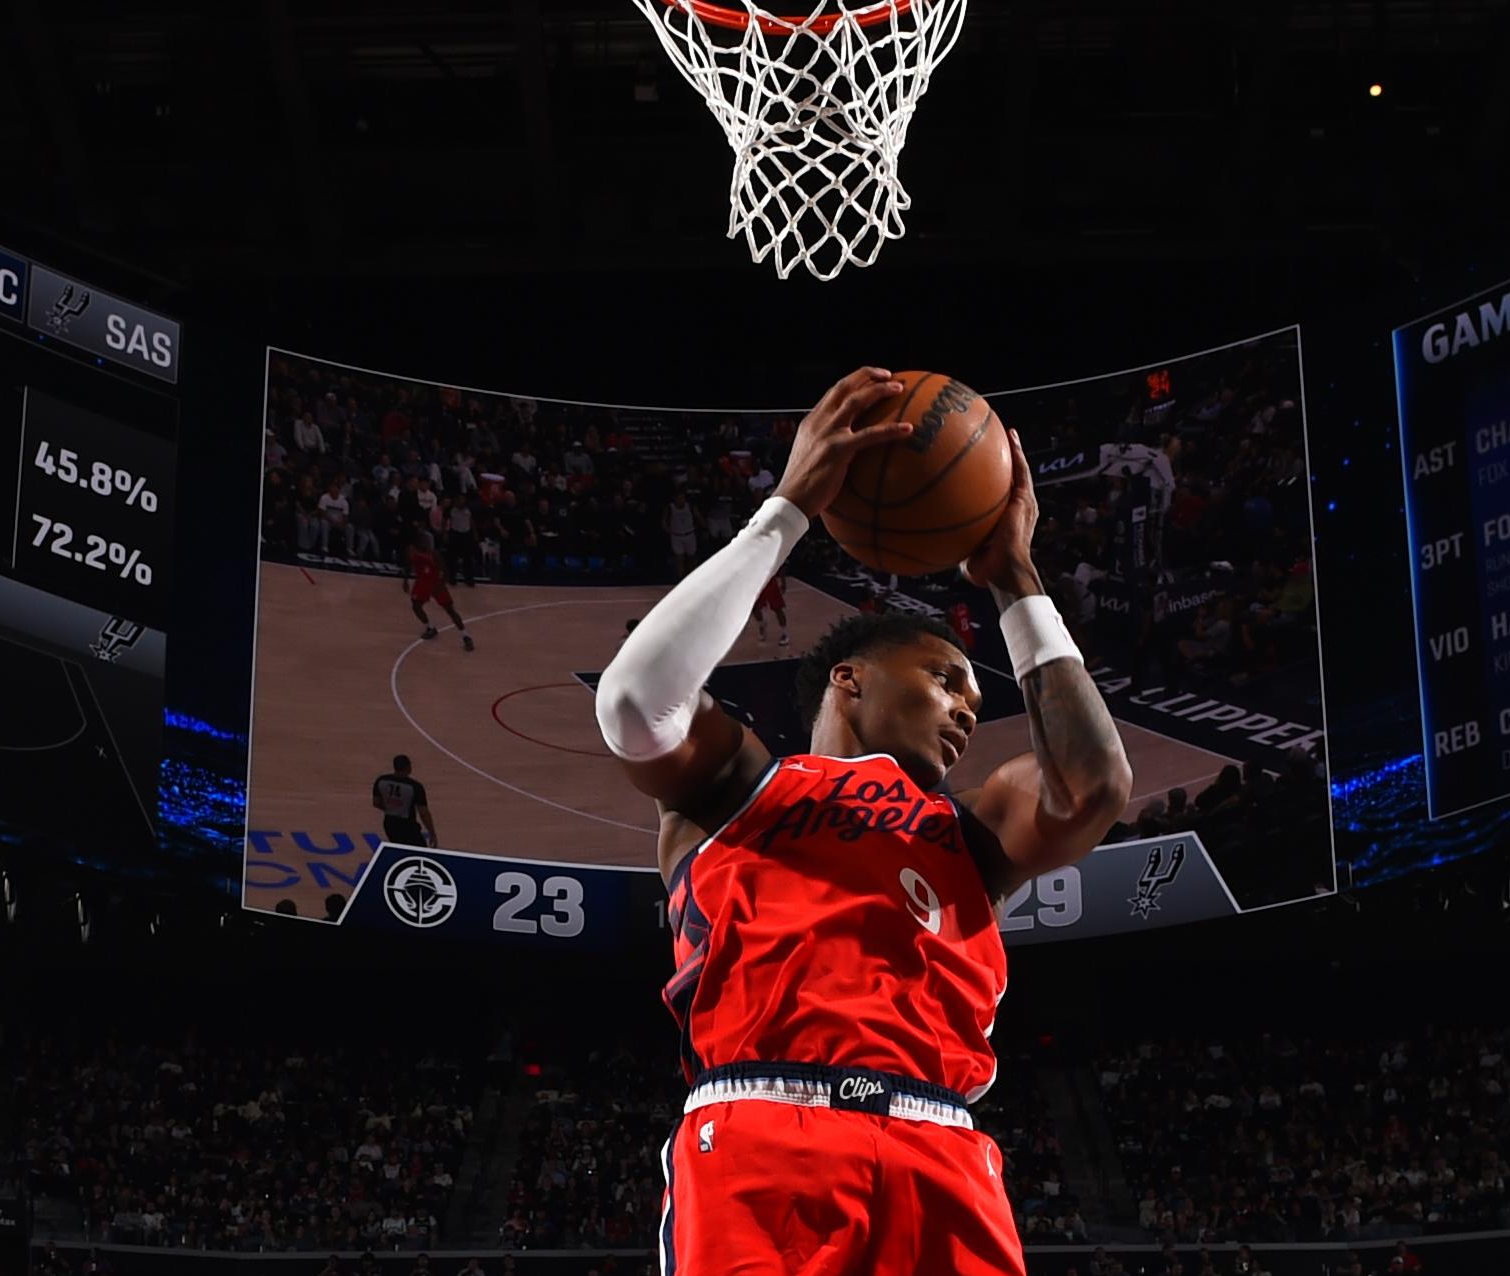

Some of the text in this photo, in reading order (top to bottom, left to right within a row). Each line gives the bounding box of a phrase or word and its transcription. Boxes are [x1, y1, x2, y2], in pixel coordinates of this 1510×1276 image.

[106, 313, 172, 368] SAS
[33, 440, 159, 513] 45.8%
[1414, 440, 1457, 481] AST
[31, 512, 153, 586] 72.2%
[1421, 531, 1464, 570] 3PT
[1429, 626, 1470, 662] VIO
[1434, 720, 1481, 758] REB
[824, 769, 910, 803] Los
[759, 797, 962, 855] Angeles
[492, 869, 587, 939] 23
[899, 867, 942, 936] 9
[999, 865, 1084, 932] 29
[839, 1076, 886, 1103] Clips
